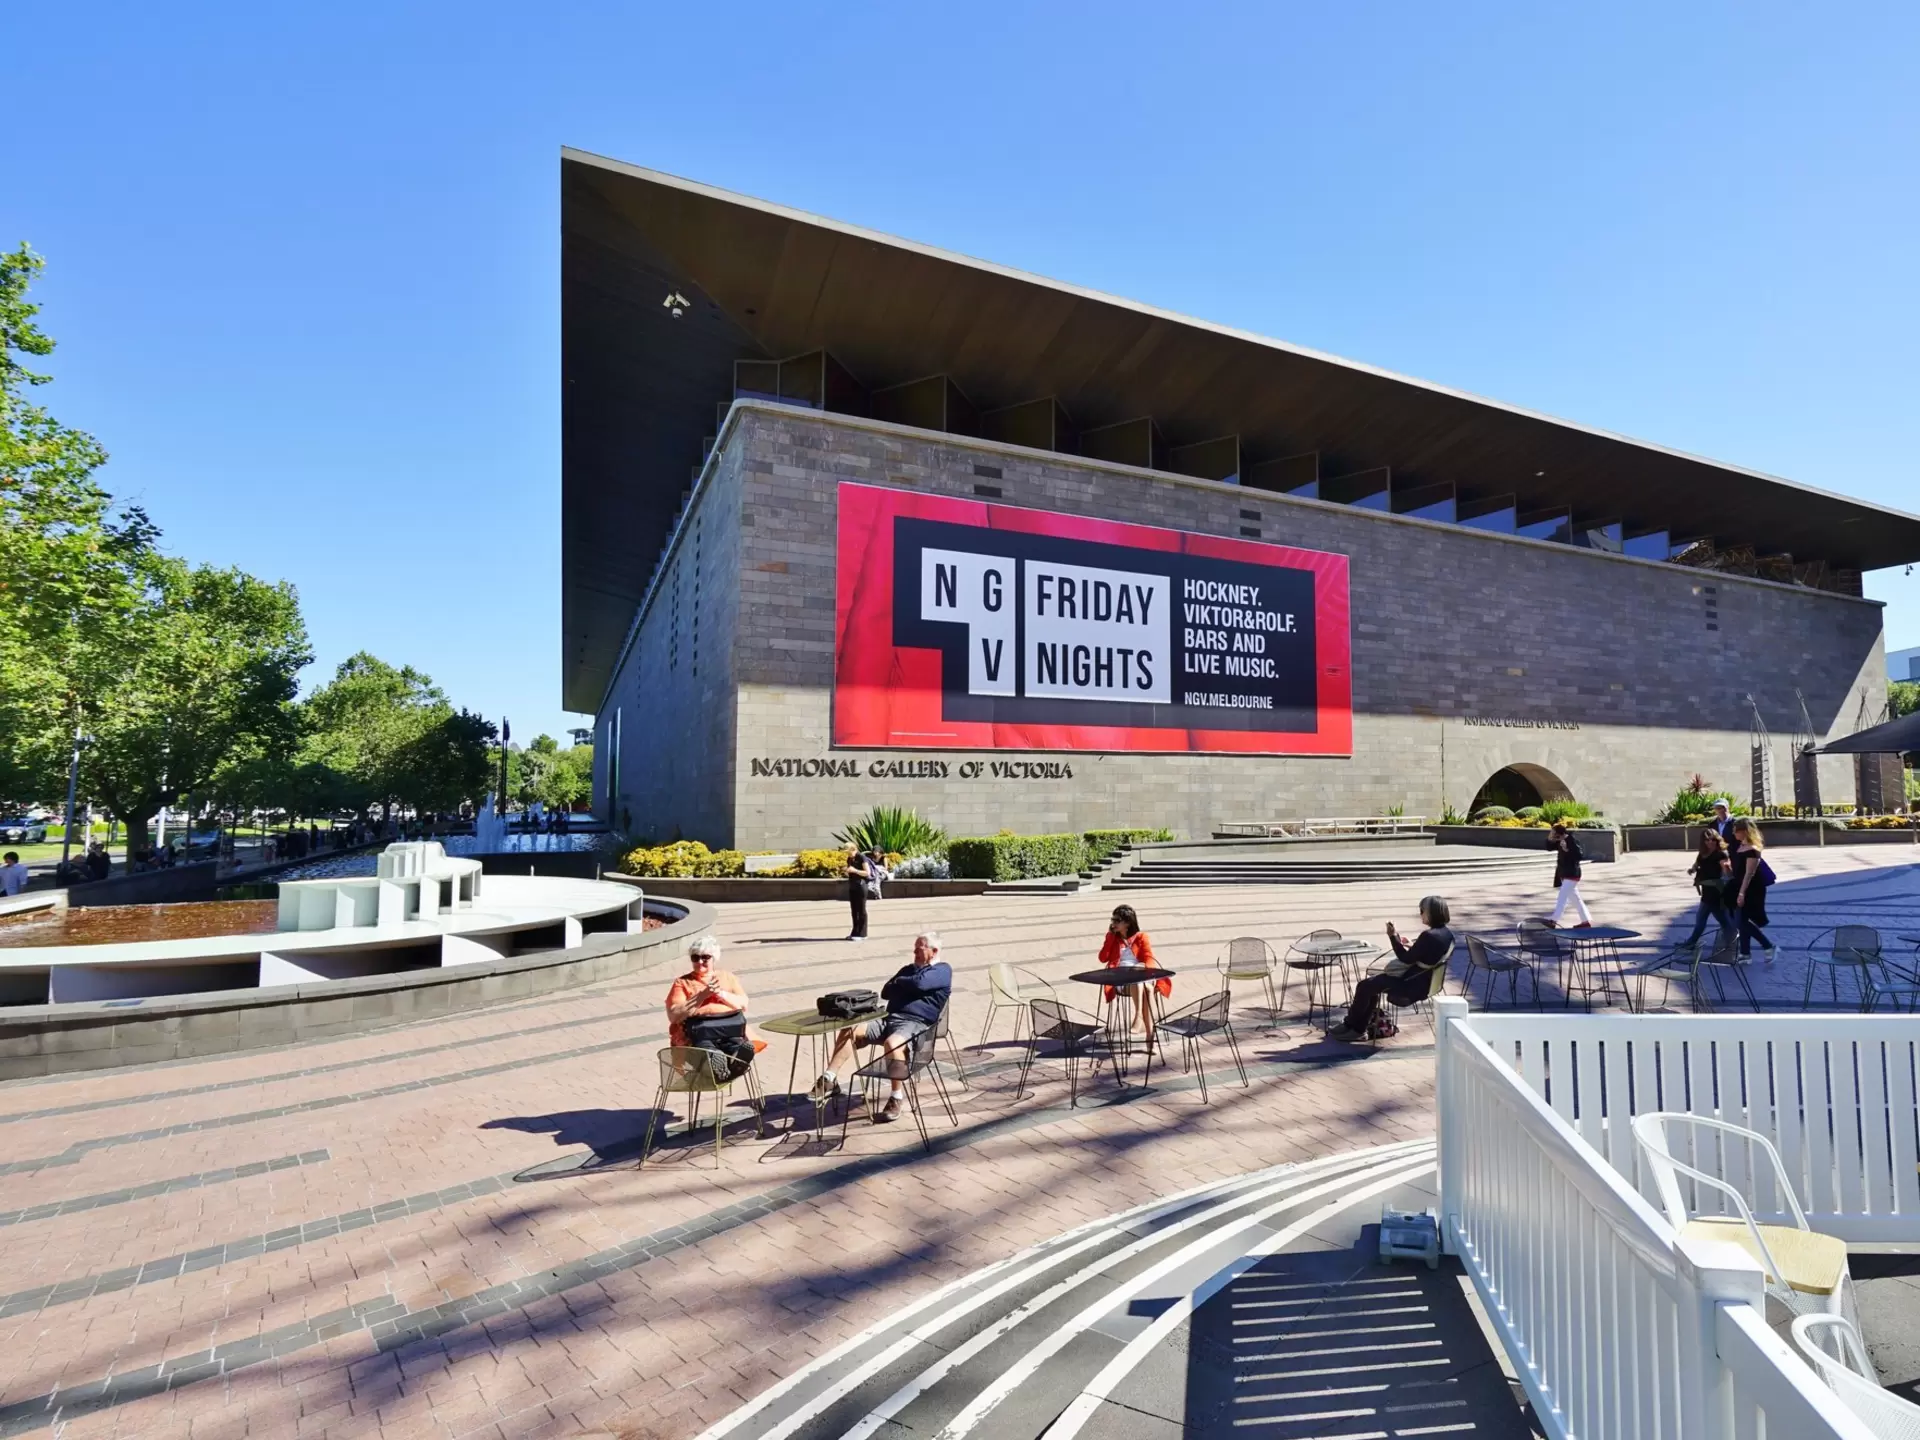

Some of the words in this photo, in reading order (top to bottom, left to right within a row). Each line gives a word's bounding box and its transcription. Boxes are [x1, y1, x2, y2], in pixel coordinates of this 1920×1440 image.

[1037, 574, 1155, 626] FRIDAY
[1184, 578, 1262, 607] HOCKNEY.
[1183, 602, 1297, 633] VIKTOR&ROLF.
[1184, 627, 1228, 651] BARS
[1232, 632, 1266, 654] AND
[1037, 641, 1154, 691] NIGHTS
[1184, 652, 1220, 675] LIVE
[1225, 655, 1280, 679] MUSIC.
[1184, 691, 1274, 710] NGV.MELBOURNE
[750, 757, 861, 778] NATIONAL
[868, 759, 951, 779] GALLERY
[958, 760, 984, 779] OF
[988, 761, 1074, 780] VICTORIA
